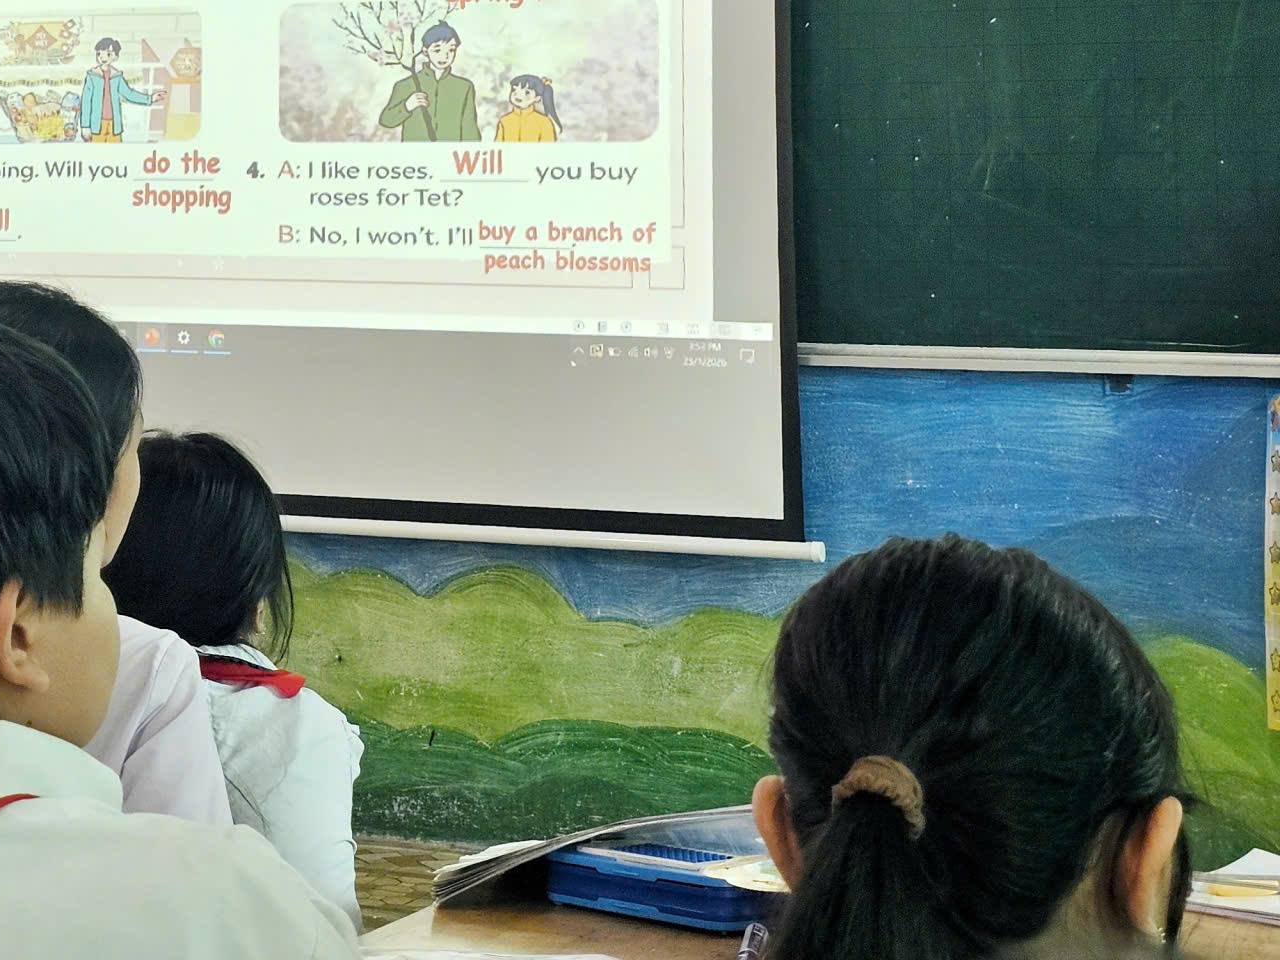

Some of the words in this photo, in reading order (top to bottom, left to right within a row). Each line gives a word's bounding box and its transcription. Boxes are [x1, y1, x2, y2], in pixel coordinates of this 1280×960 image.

[44, 160, 83, 178] Will
[89, 164, 128, 184] you
[142, 149, 171, 175] do
[181, 149, 220, 174] the
[246, 162, 265, 180] 4.
[278, 161, 302, 179] A:
[308, 162, 313, 179] I
[321, 159, 360, 179] like
[367, 164, 433, 180] roses.
[452, 149, 504, 178] Will
[536, 165, 582, 184] you
[590, 161, 638, 185] buy
[132, 185, 232, 214] shopping
[309, 191, 369, 207] roses
[376, 188, 409, 207] for
[413, 188, 464, 207] Tet?
[278, 225, 301, 244] B:
[309, 227, 348, 246] No,
[355, 227, 361, 245] I
[367, 226, 439, 246] won't.
[447, 227, 473, 246] I'll
[479, 219, 515, 245] buy
[524, 224, 538, 243] a
[548, 221, 622, 244] branch
[632, 221, 657, 244] of
[484, 250, 545, 275] peach
[555, 250, 652, 274] blossoms
